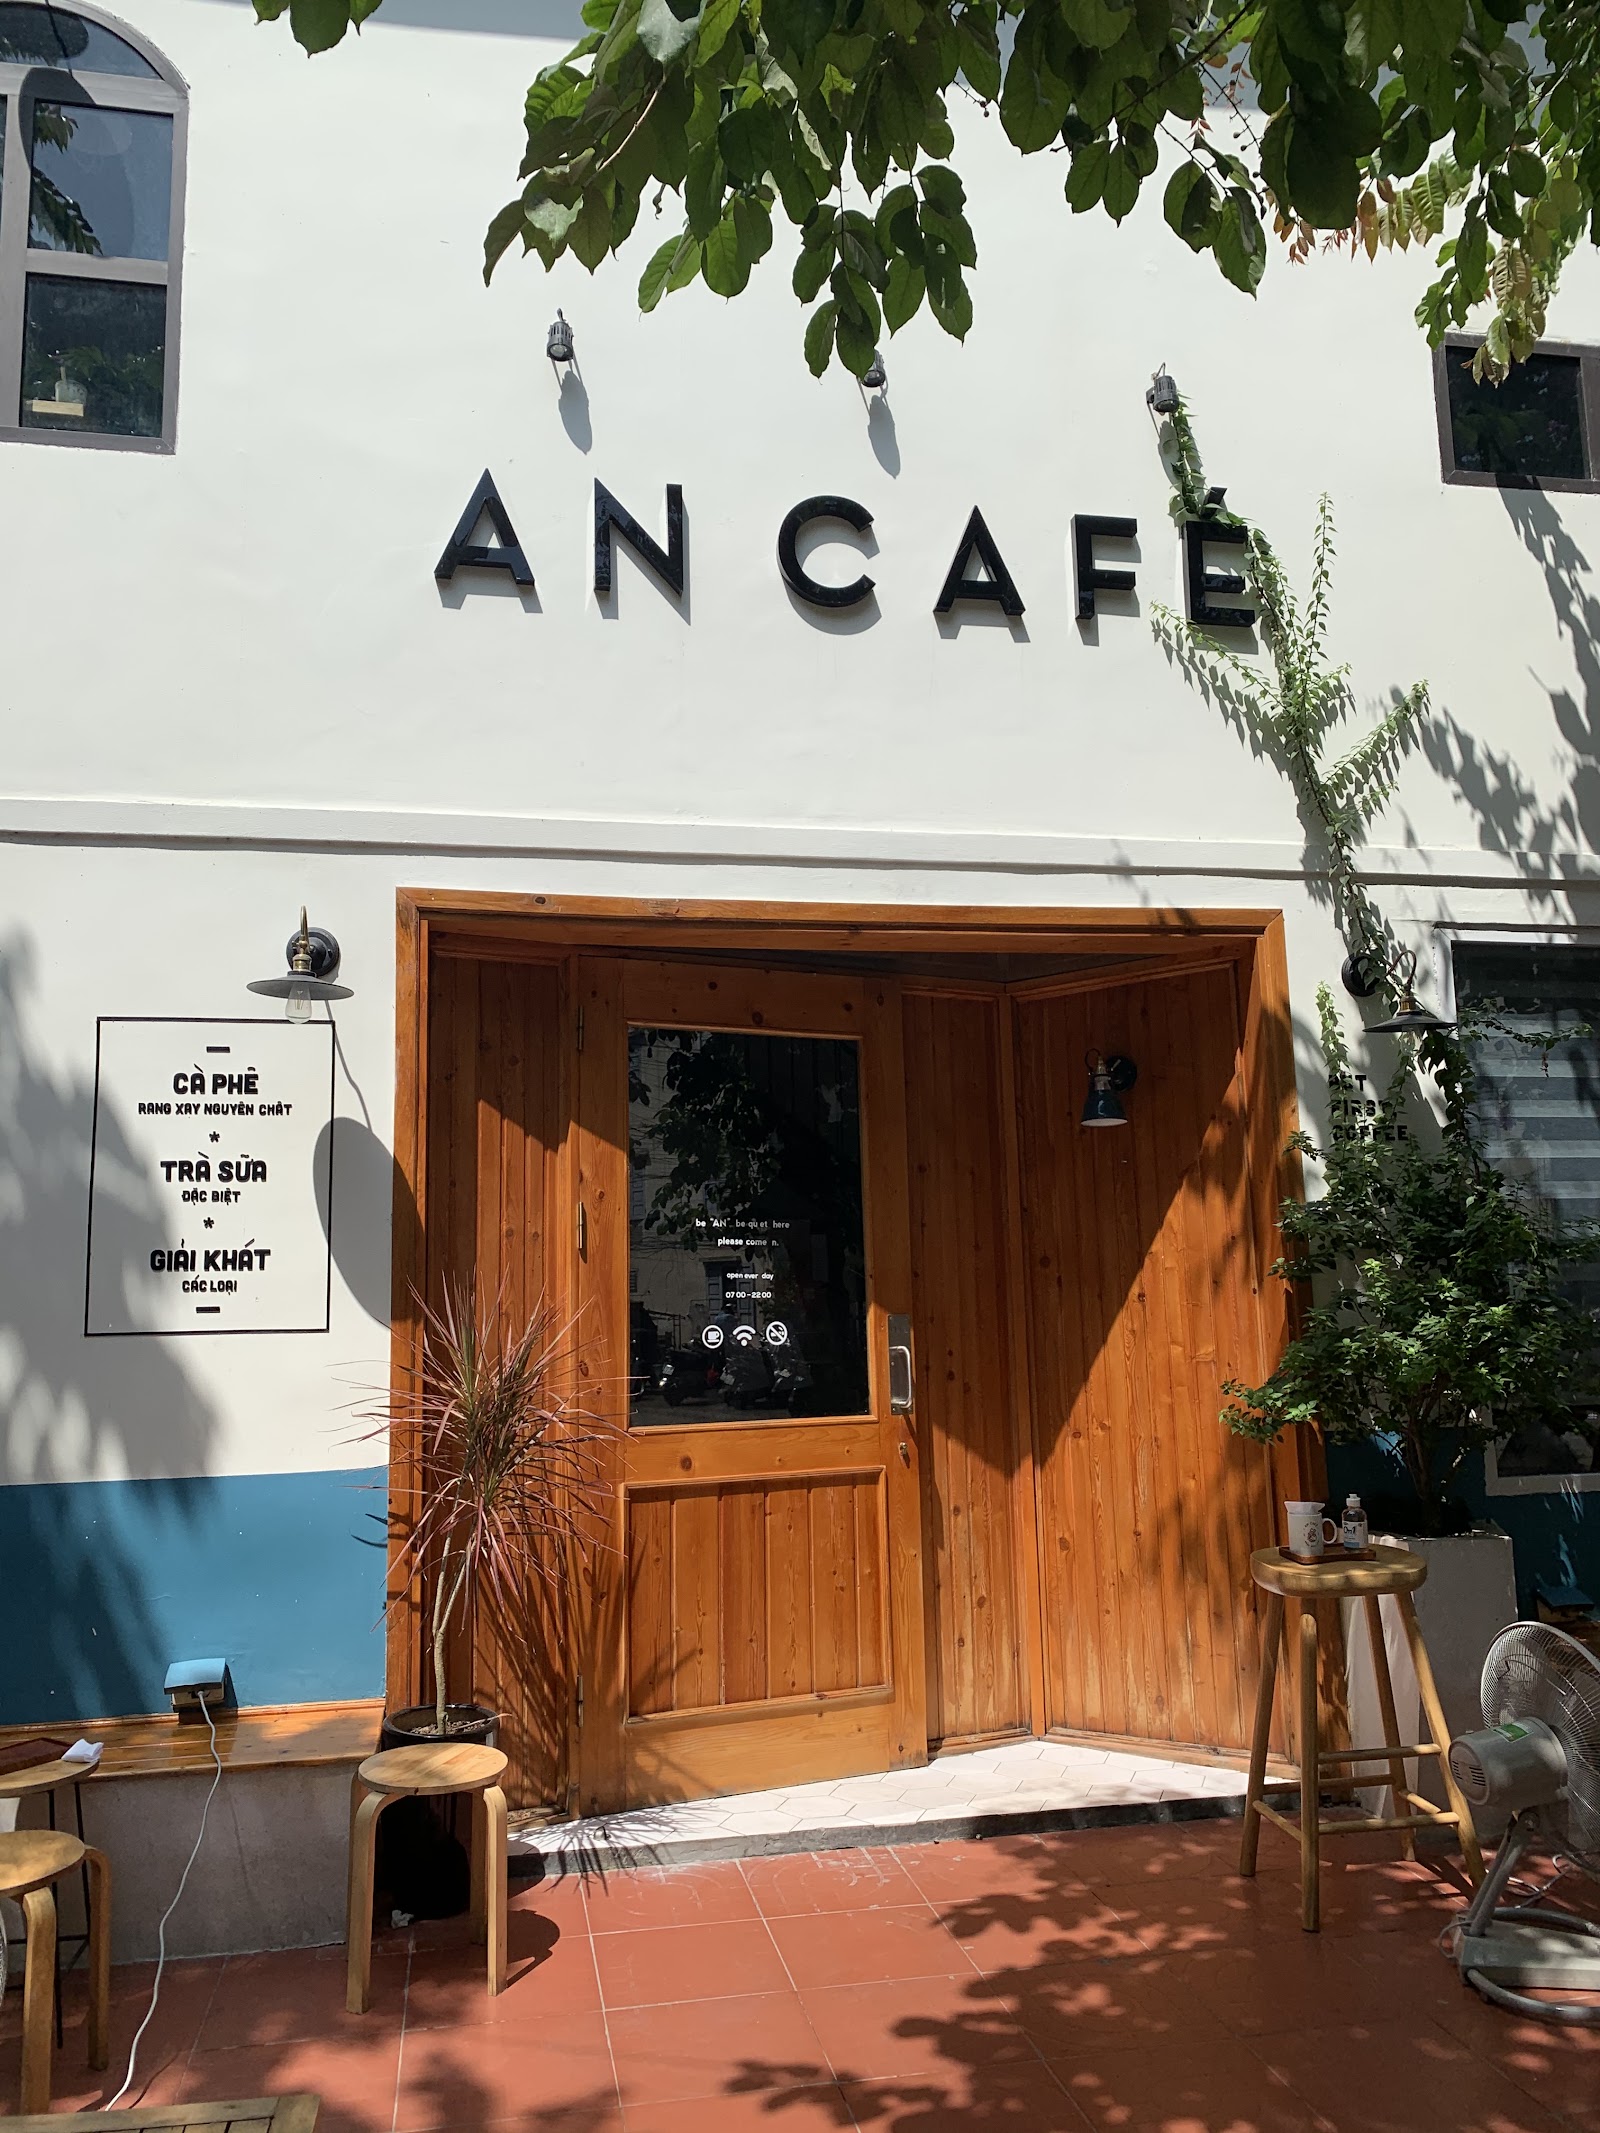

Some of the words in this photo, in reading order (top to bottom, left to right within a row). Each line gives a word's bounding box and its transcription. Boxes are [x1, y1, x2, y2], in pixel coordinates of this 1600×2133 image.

[434, 468, 683, 597] AN
[778, 487, 1257, 628] CAFÉ
[173, 1063, 206, 1095] CÀ
[212, 1067, 259, 1095] PHÊ
[138, 1102, 172, 1116] RANG
[175, 1102, 201, 1116] XAY
[204, 1101, 254, 1116] NGUYÊN
[160, 1151, 211, 1183] TRÀ
[217, 1153, 267, 1183] SỮA
[211, 1187, 241, 1206] BIỆT
[696, 1218, 706, 1227] be
[735, 1218, 746, 1228] be
[748, 1220, 768, 1230] quet
[773, 1220, 790, 1228] here
[718, 1236, 743, 1246] please
[745, 1238, 767, 1246] come
[150, 1238, 196, 1273] GIẢI
[203, 1239, 271, 1272] KHÁT
[182, 1275, 207, 1293] CÁC
[209, 1279, 238, 1296] LOẠI
[726, 1272, 744, 1280] open
[761, 1272, 774, 1280] day
